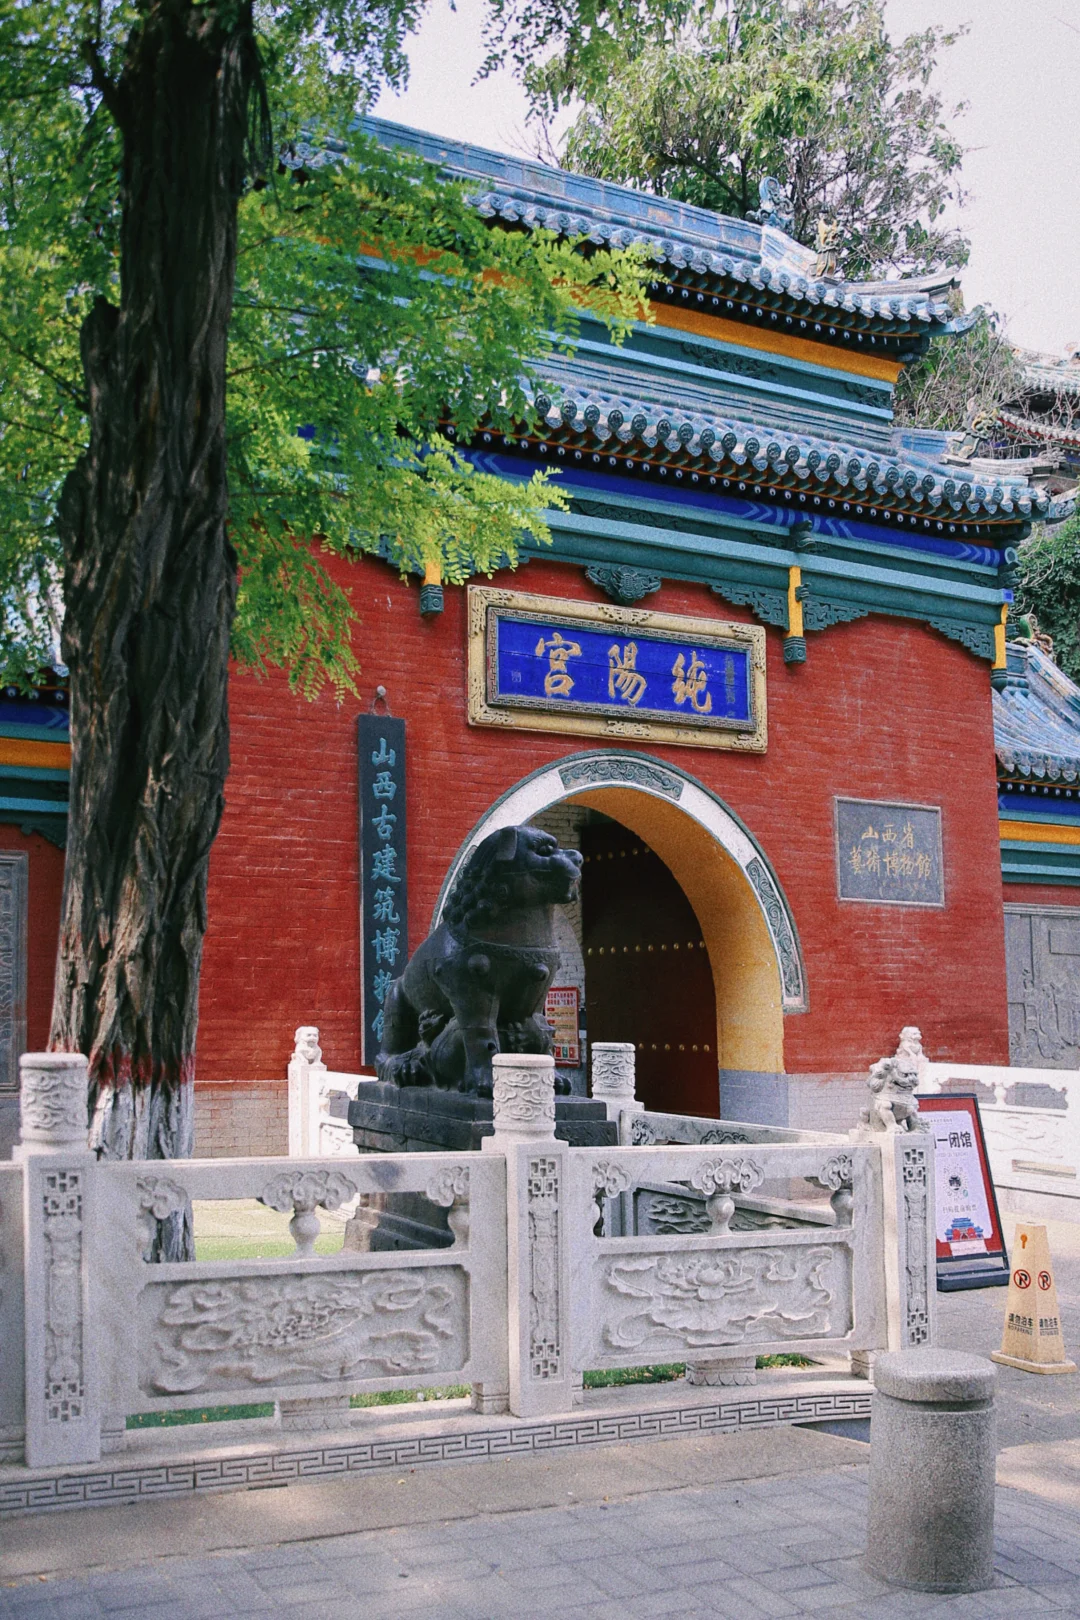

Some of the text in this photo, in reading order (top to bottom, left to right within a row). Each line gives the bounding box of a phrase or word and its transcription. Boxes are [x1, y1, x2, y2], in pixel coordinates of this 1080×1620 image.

[861, 821, 915, 849] 山西省
[933, 1131, 973, 1149] 一闭馆
[1008, 1312, 1033, 1327] 请勿泊车
